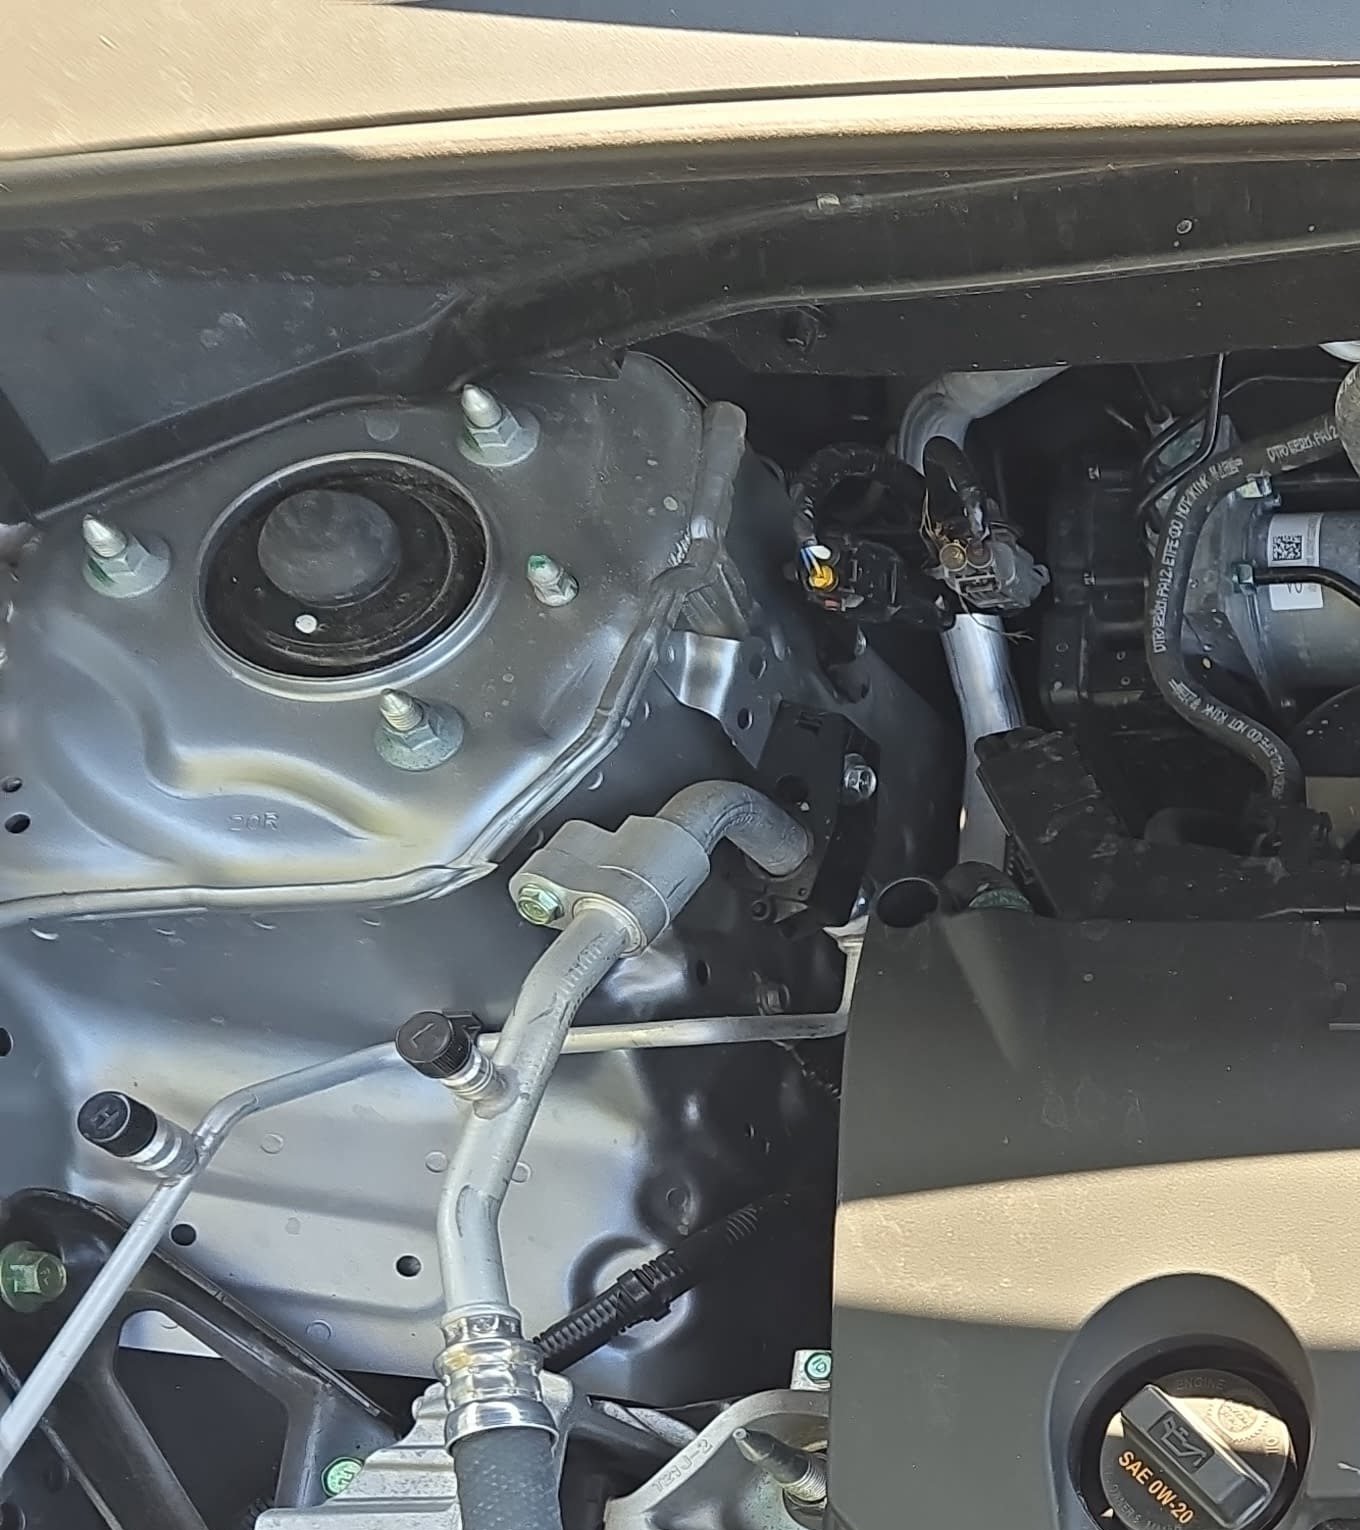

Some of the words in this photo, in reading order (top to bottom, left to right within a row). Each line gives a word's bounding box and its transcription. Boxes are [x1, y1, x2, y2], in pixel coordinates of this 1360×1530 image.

[1176, 1378, 1226, 1390] ENGINE
[1118, 1451, 1154, 1485] SAE
[1148, 1480, 1193, 1525] 0W-20
